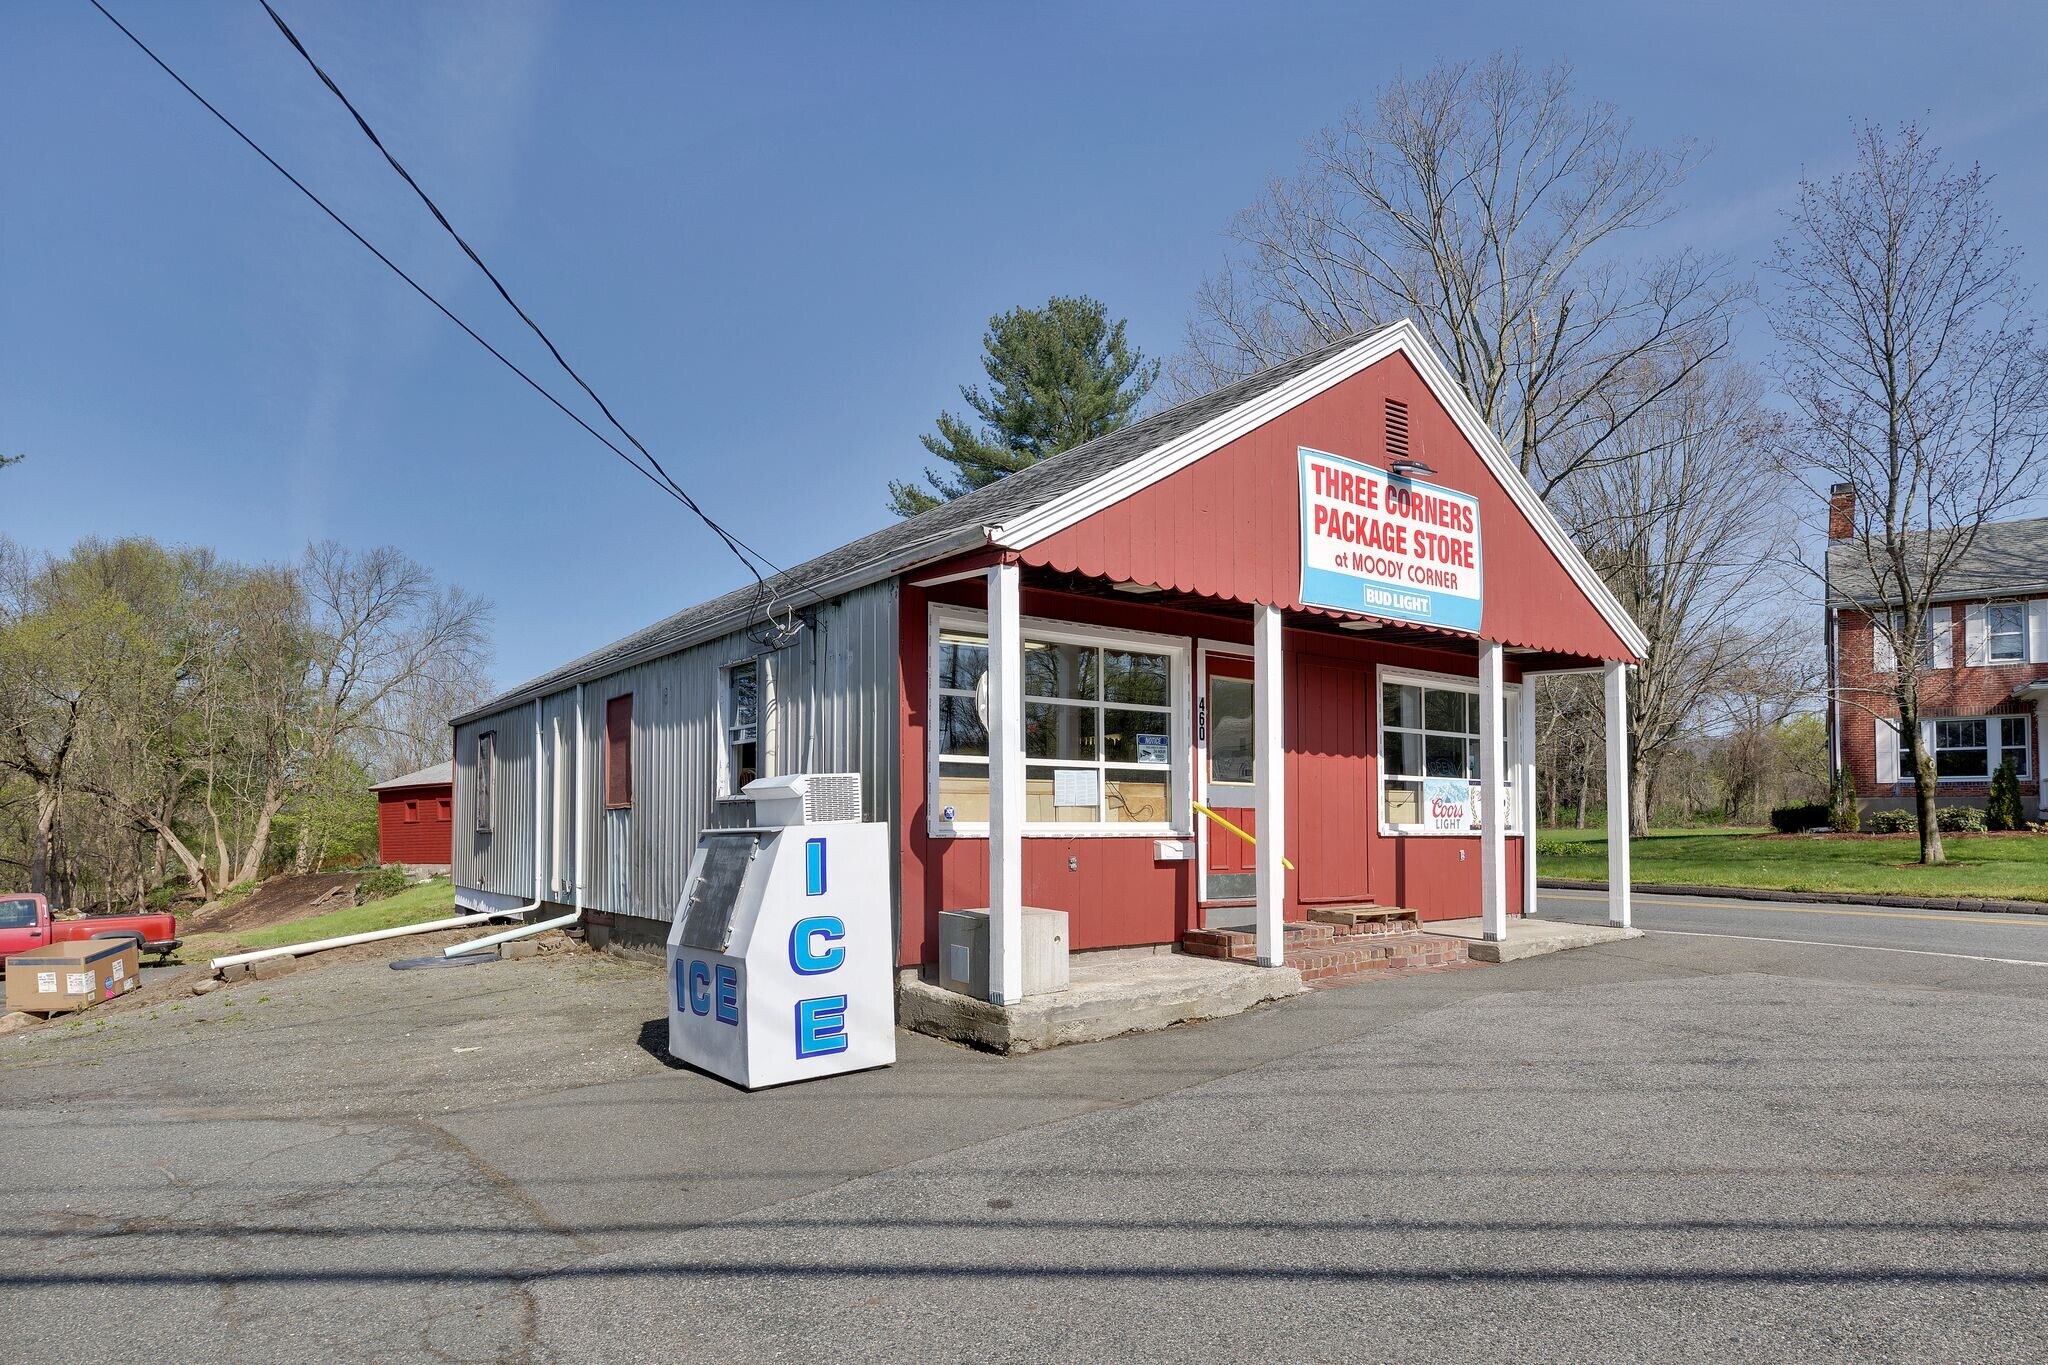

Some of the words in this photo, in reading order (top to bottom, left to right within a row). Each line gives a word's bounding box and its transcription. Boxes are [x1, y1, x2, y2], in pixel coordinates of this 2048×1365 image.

[1311, 463, 1378, 511] THREE
[1384, 484, 1474, 534] CORNERS
[1314, 503, 1407, 556] PACKAGE
[1413, 529, 1475, 569] STORE
[1334, 552, 1349, 569] at
[1352, 551, 1404, 580] MOODY
[1407, 564, 1458, 590] CORNER
[1366, 588, 1392, 606] BUD
[1393, 593, 1429, 613] LIGHT
[1145, 736, 1161, 745] NOTICE
[1431, 798, 1464, 819] Coors
[1435, 818, 1461, 830] LIGHT
[788, 837, 848, 1060] ICE
[675, 958, 739, 1027] ICE
